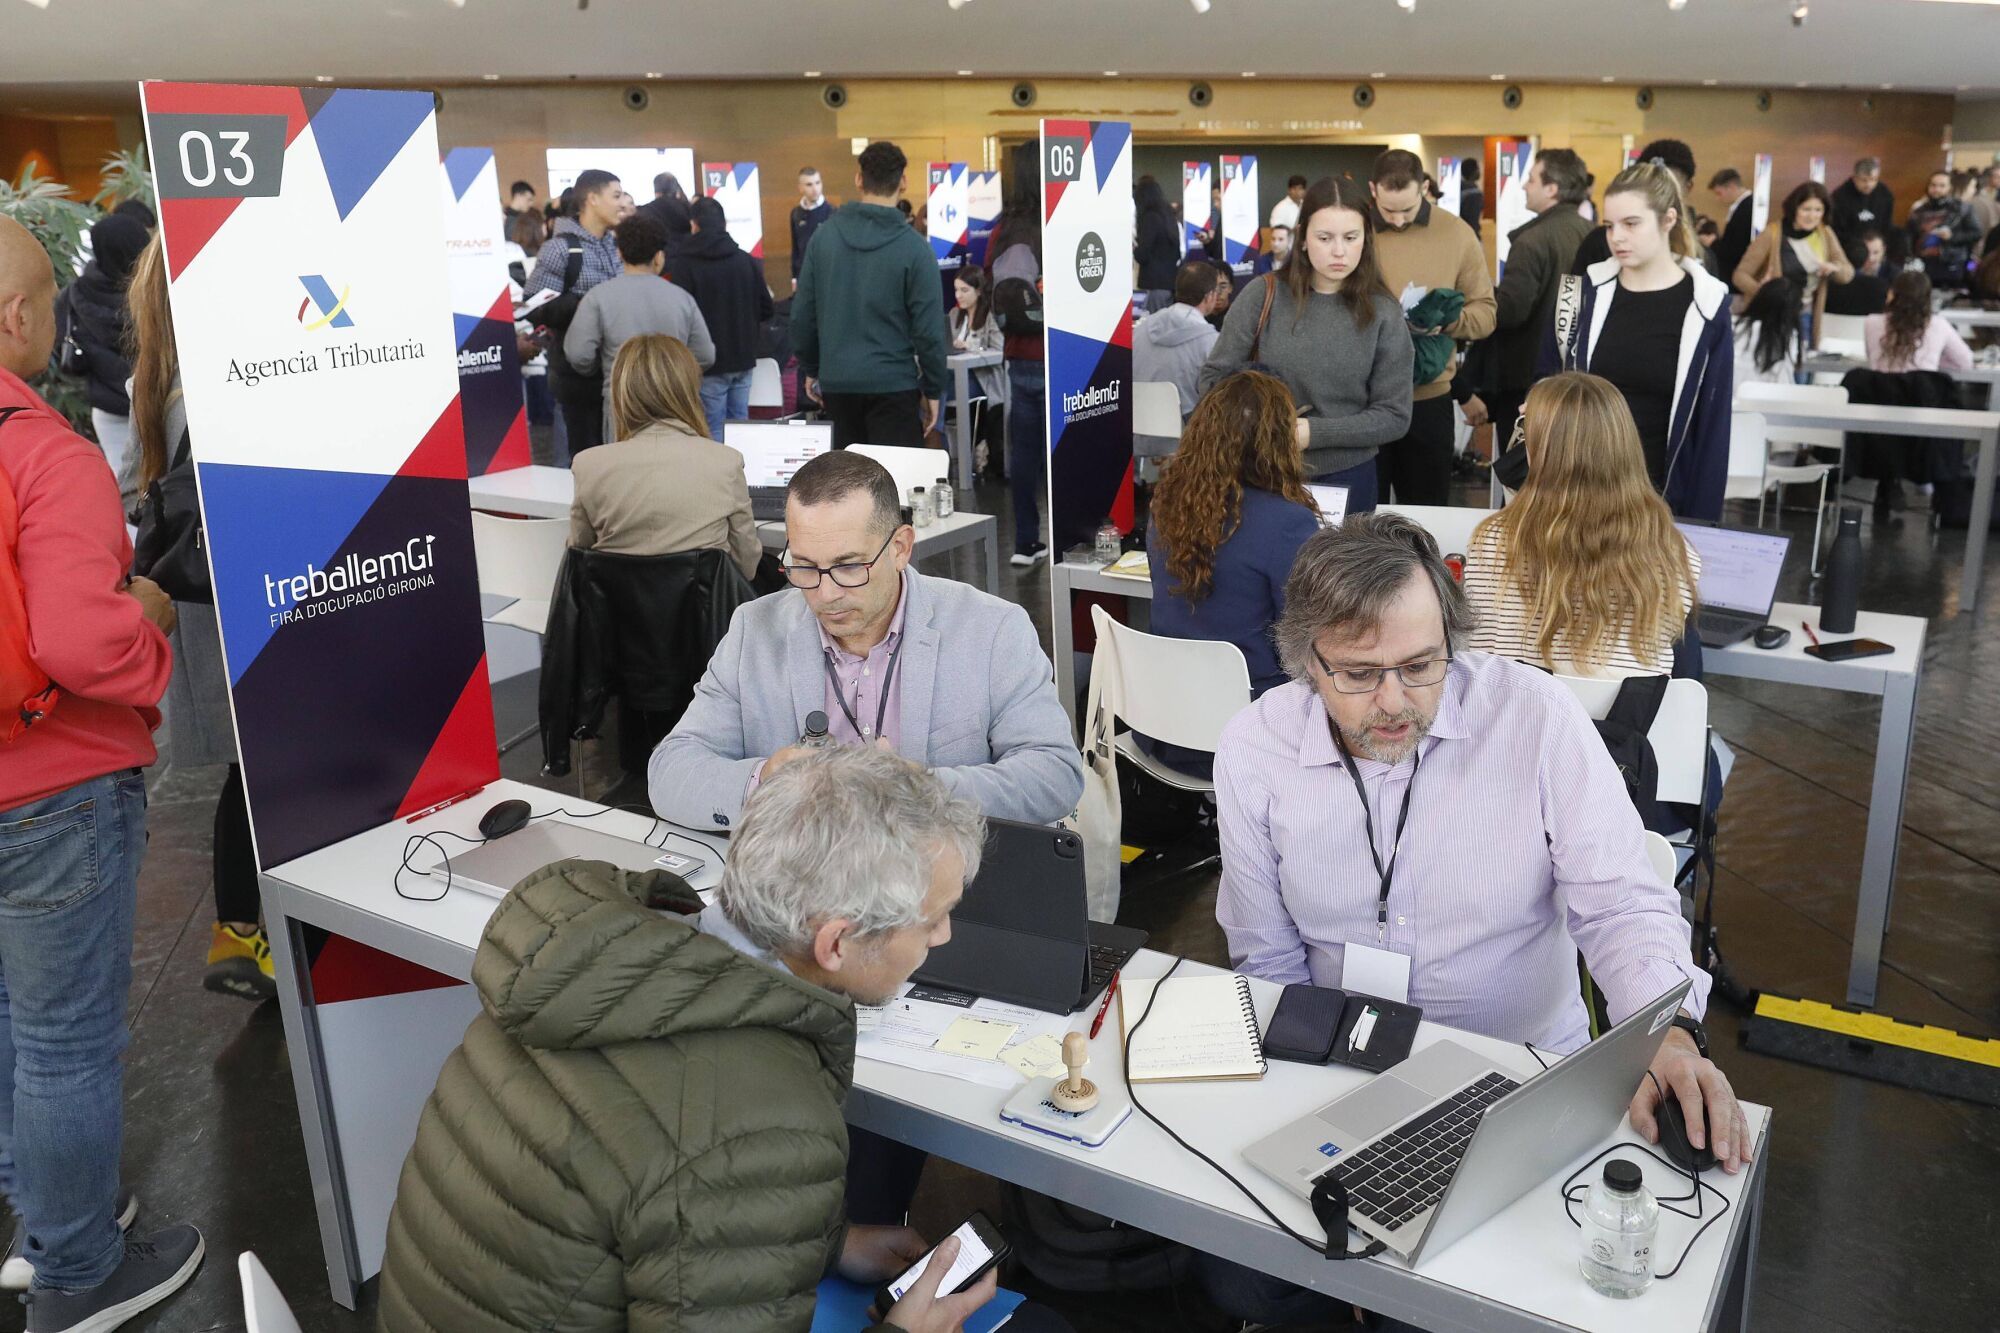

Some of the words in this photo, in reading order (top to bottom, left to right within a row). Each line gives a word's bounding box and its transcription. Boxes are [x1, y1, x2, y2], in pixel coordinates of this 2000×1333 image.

[179, 130, 255, 188] 03
[709, 172, 722, 187] 12
[1051, 145, 1074, 177] 06
[1080, 265, 1103, 278] ORIGEN
[225, 350, 319, 387] Agencia
[325, 338, 425, 370] Tributaria
[1063, 380, 1120, 413] treballemGi
[264, 534, 436, 608] treballemGi
[270, 607, 304, 629] FIRA
[306, 583, 385, 619] D'OCUPACIÓ
[388, 573, 435, 597] GIRONA
